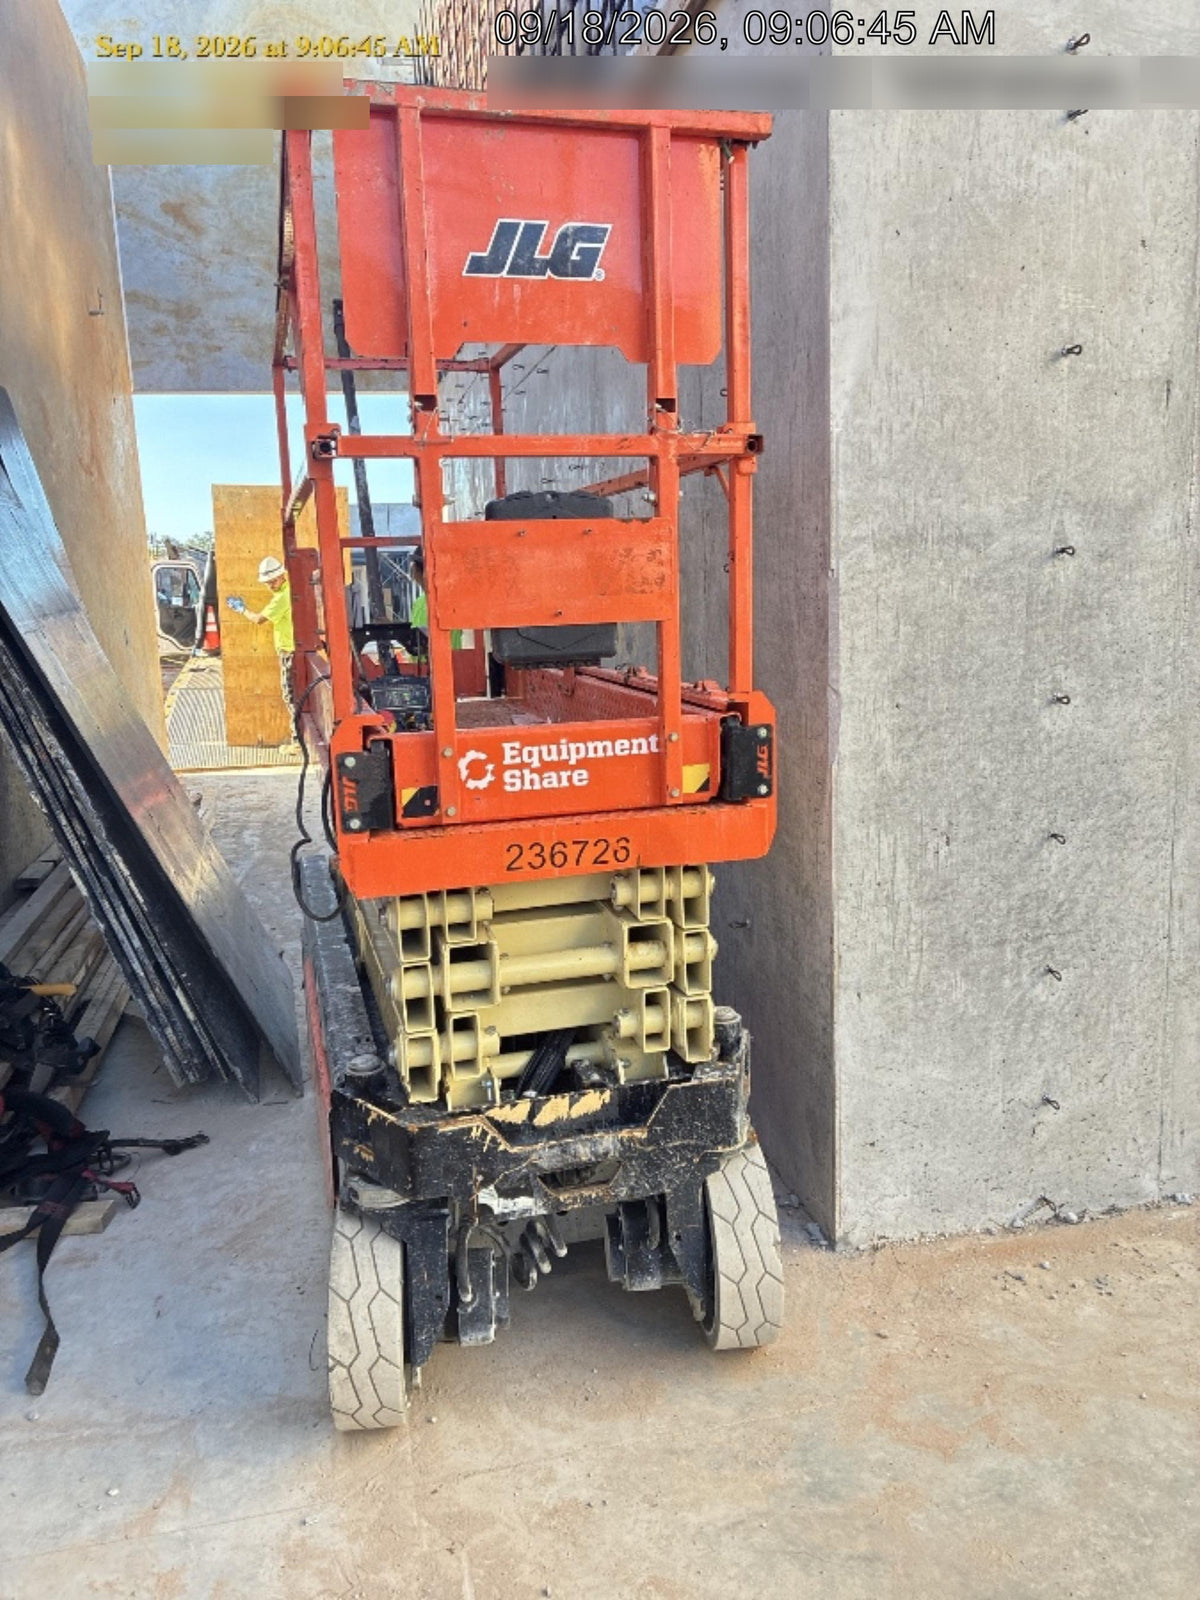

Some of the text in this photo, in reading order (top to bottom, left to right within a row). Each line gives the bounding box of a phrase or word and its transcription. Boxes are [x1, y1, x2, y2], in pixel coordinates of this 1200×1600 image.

[462, 218, 613, 281] JLG
[502, 733, 660, 768] Equipment
[756, 744, 769, 778] JLG
[342, 775, 359, 813] JLG
[503, 768, 589, 792] Share
[505, 836, 631, 872] 236726
